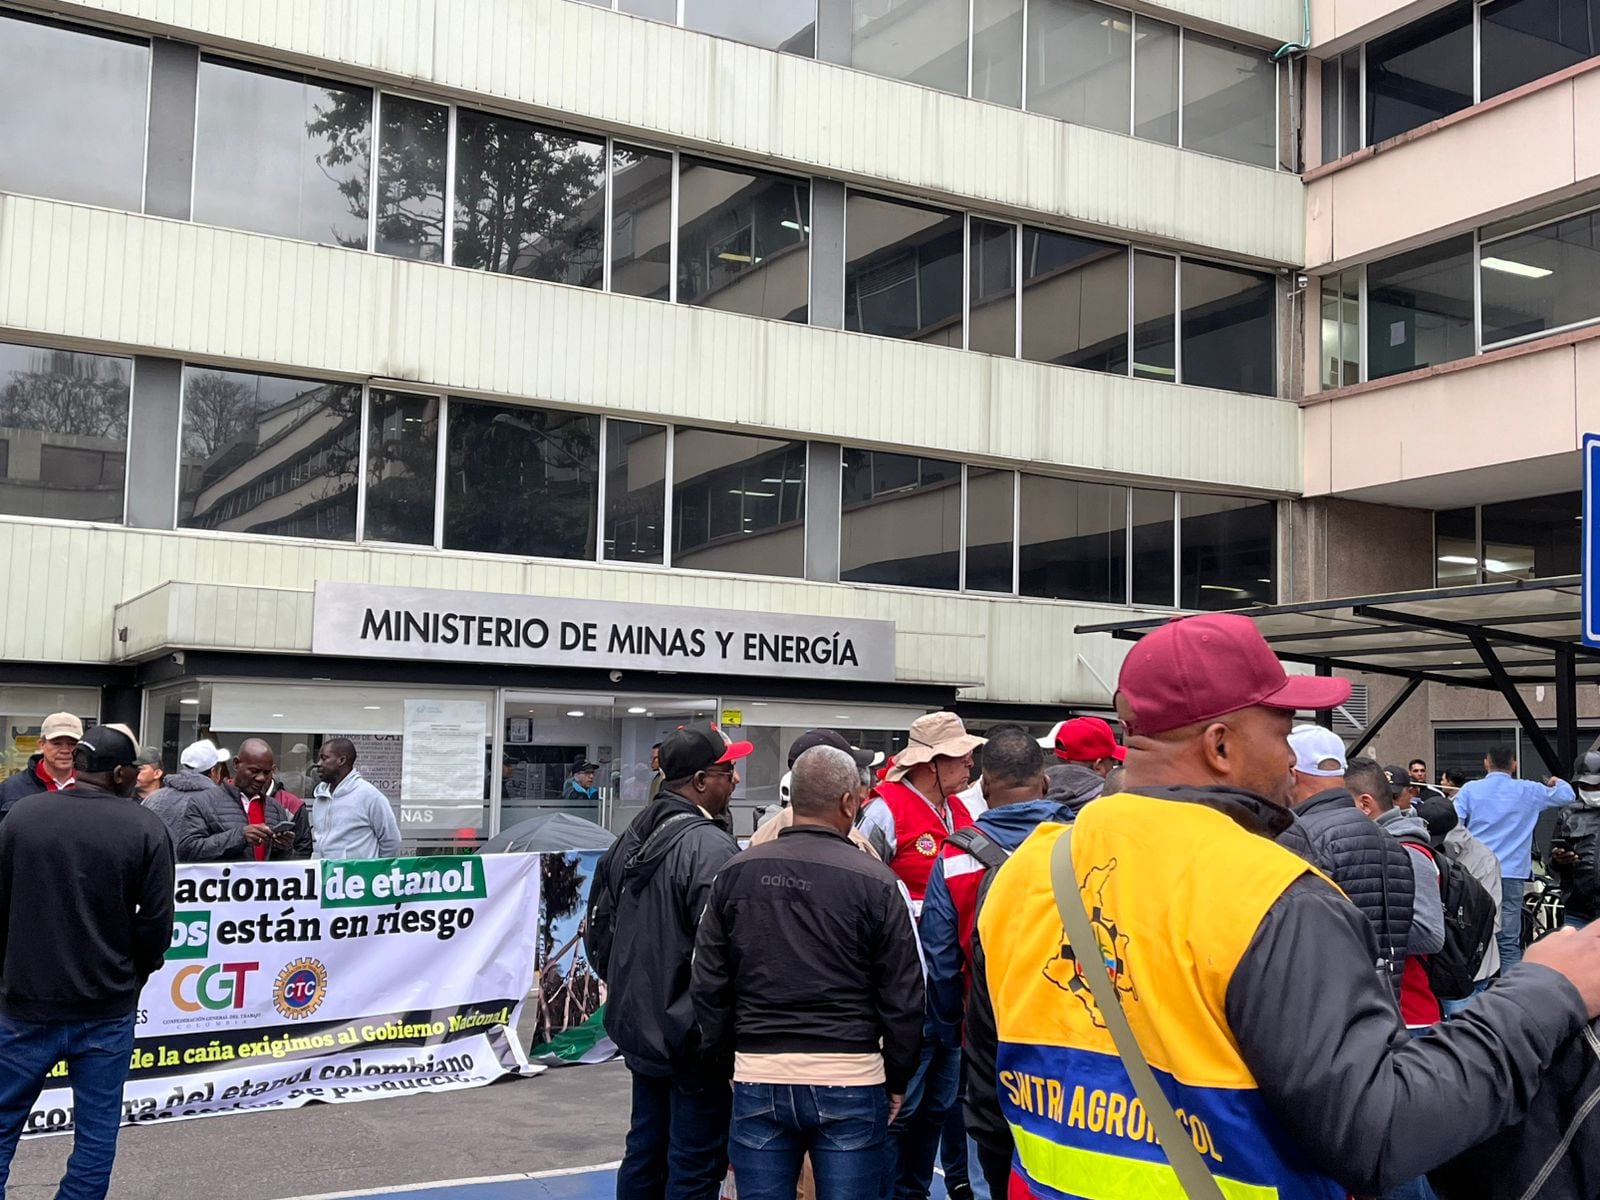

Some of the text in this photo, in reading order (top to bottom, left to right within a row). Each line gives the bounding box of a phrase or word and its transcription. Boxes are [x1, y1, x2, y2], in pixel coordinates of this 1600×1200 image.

[361, 608, 859, 667] MINISTERIO DE MINAS Y ENERGÍA
[400, 809, 434, 823] NAS
[174, 861, 475, 903] acional de etanol
[761, 874, 813, 891] adidas
[170, 904, 475, 948] os están en riesgo
[170, 961, 259, 1012] CGT
[284, 981, 315, 998] CTC
[134, 1010, 148, 1024] ES
[130, 1048, 154, 1069] de
[158, 1046, 180, 1067] la
[184, 1041, 236, 1063] caña
[239, 1034, 335, 1059] exigimos
[338, 1025, 358, 1044] al
[361, 1018, 445, 1041] Gobierno
[166, 1082, 214, 1108] del
